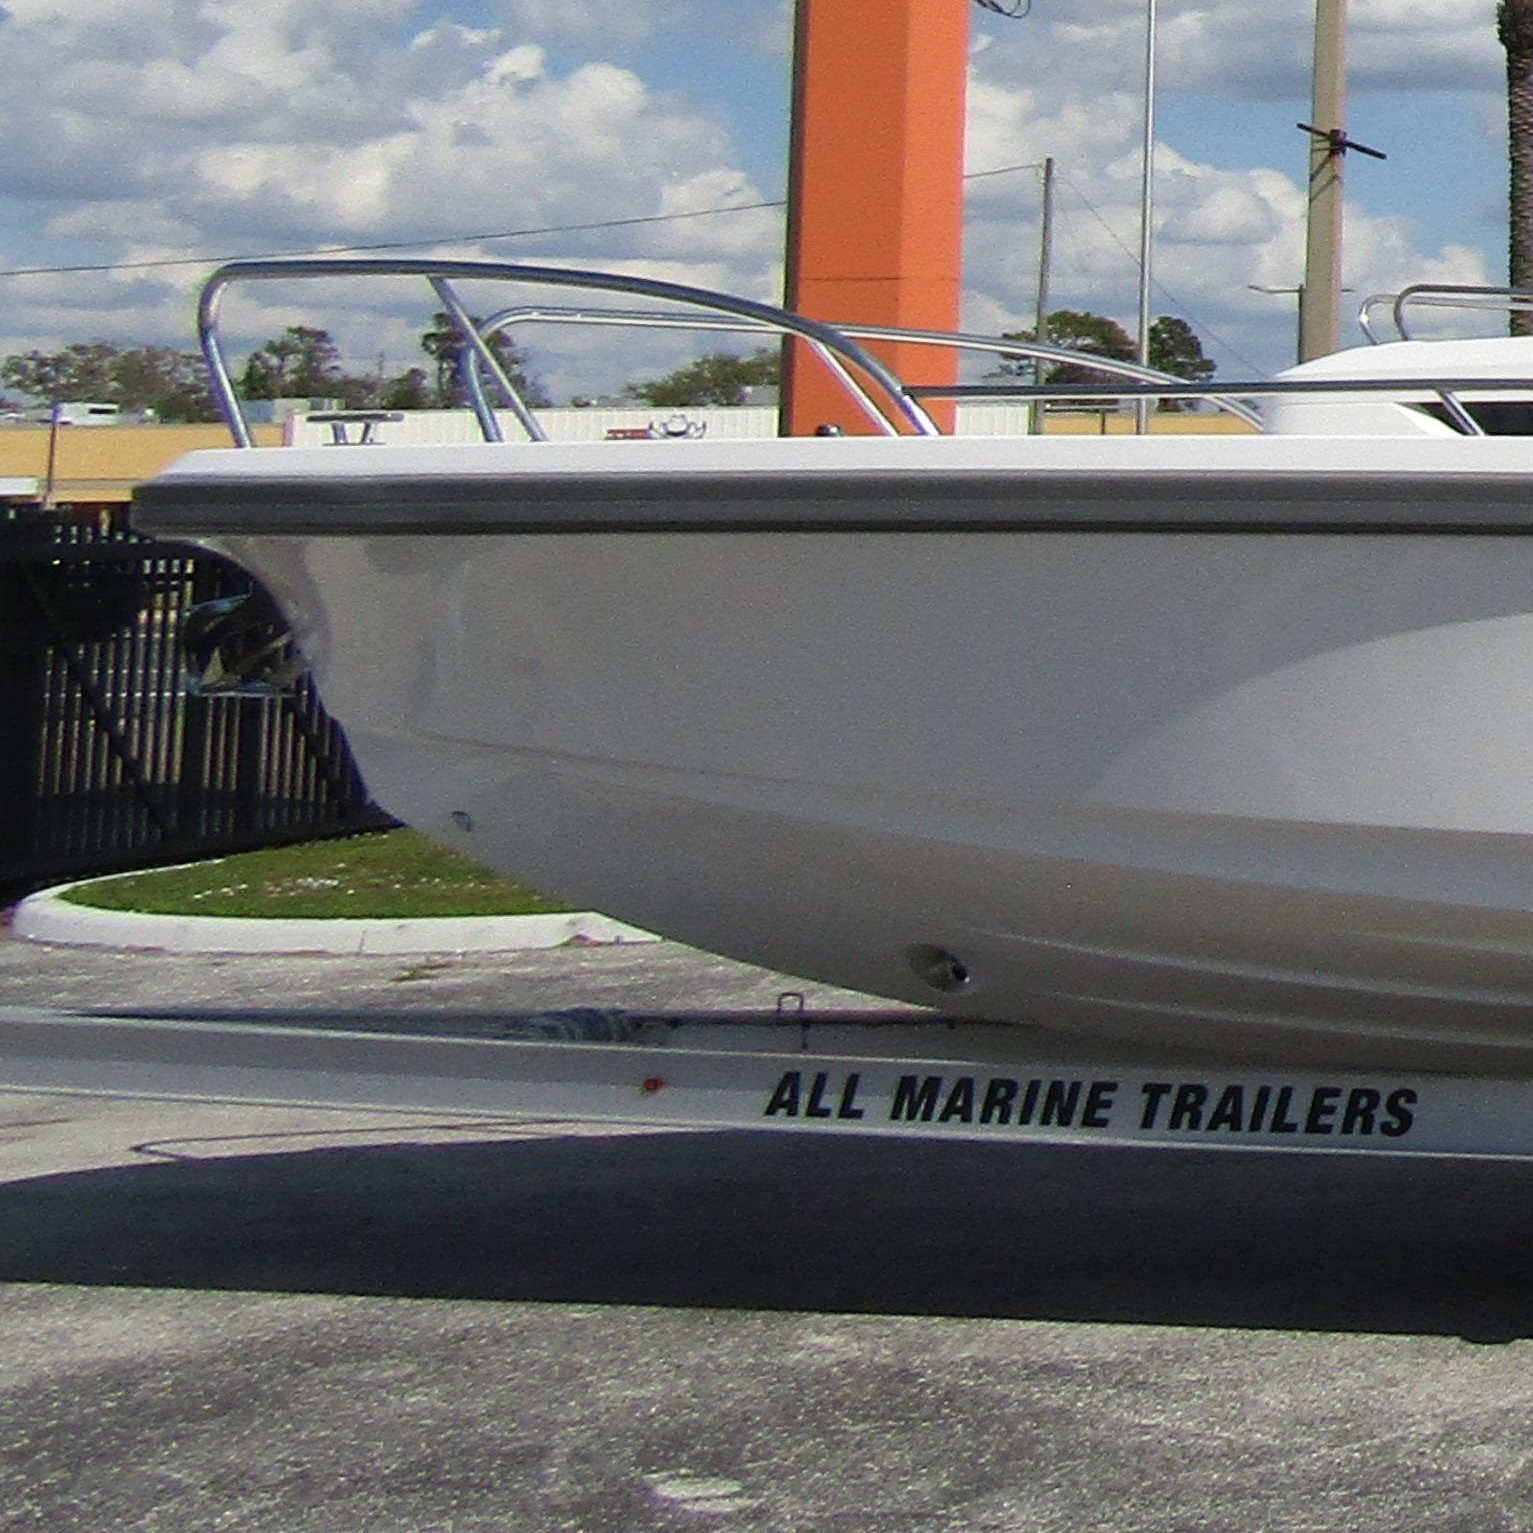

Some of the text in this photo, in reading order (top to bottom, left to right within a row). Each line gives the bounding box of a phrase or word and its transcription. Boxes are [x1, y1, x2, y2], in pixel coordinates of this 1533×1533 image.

[763, 1070, 1420, 1138] ALL MARINE TRAILERS
